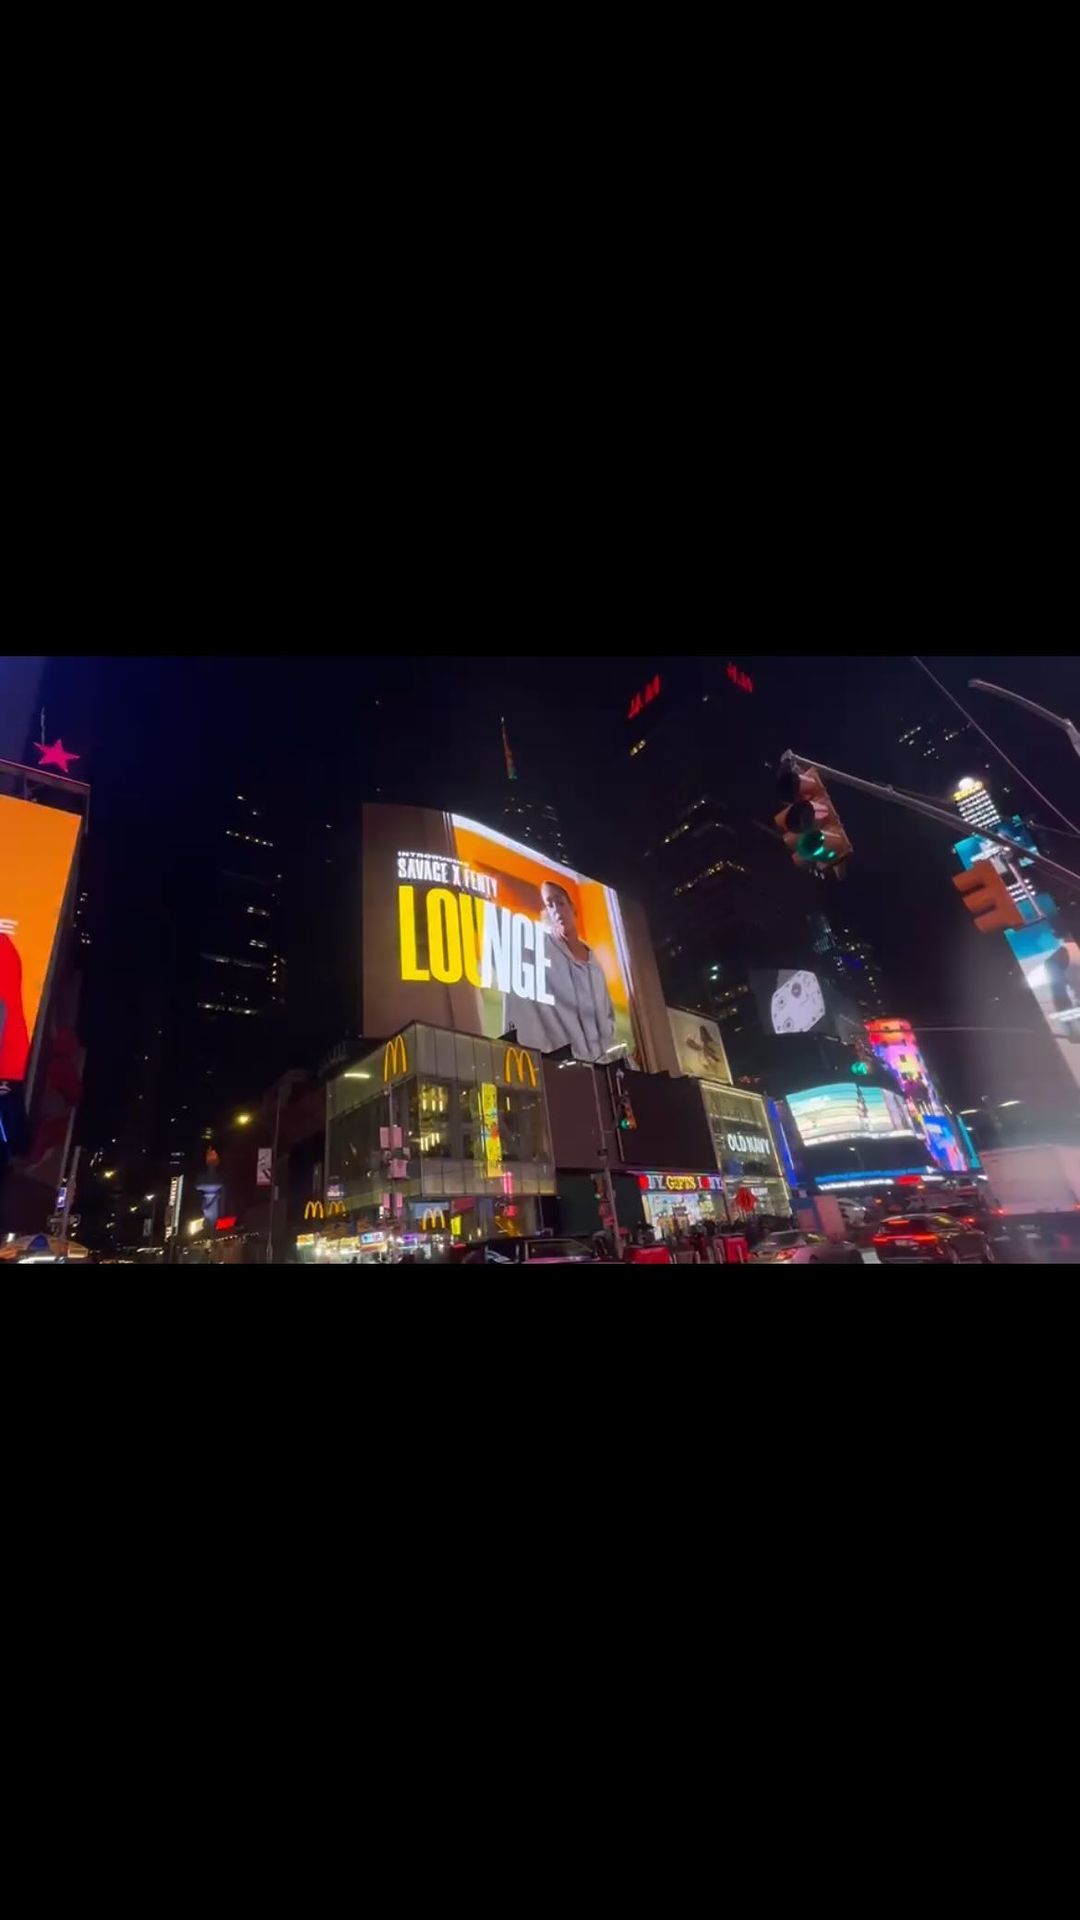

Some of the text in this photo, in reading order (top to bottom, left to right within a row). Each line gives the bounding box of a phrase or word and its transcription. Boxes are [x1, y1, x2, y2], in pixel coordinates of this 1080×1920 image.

[397, 857, 498, 899] SAVAGE X FENTY
[398, 885, 556, 1006] LOUNGE
[727, 1133, 771, 1155] OLD NAVY
[666, 1175, 697, 1191] GIFTS
